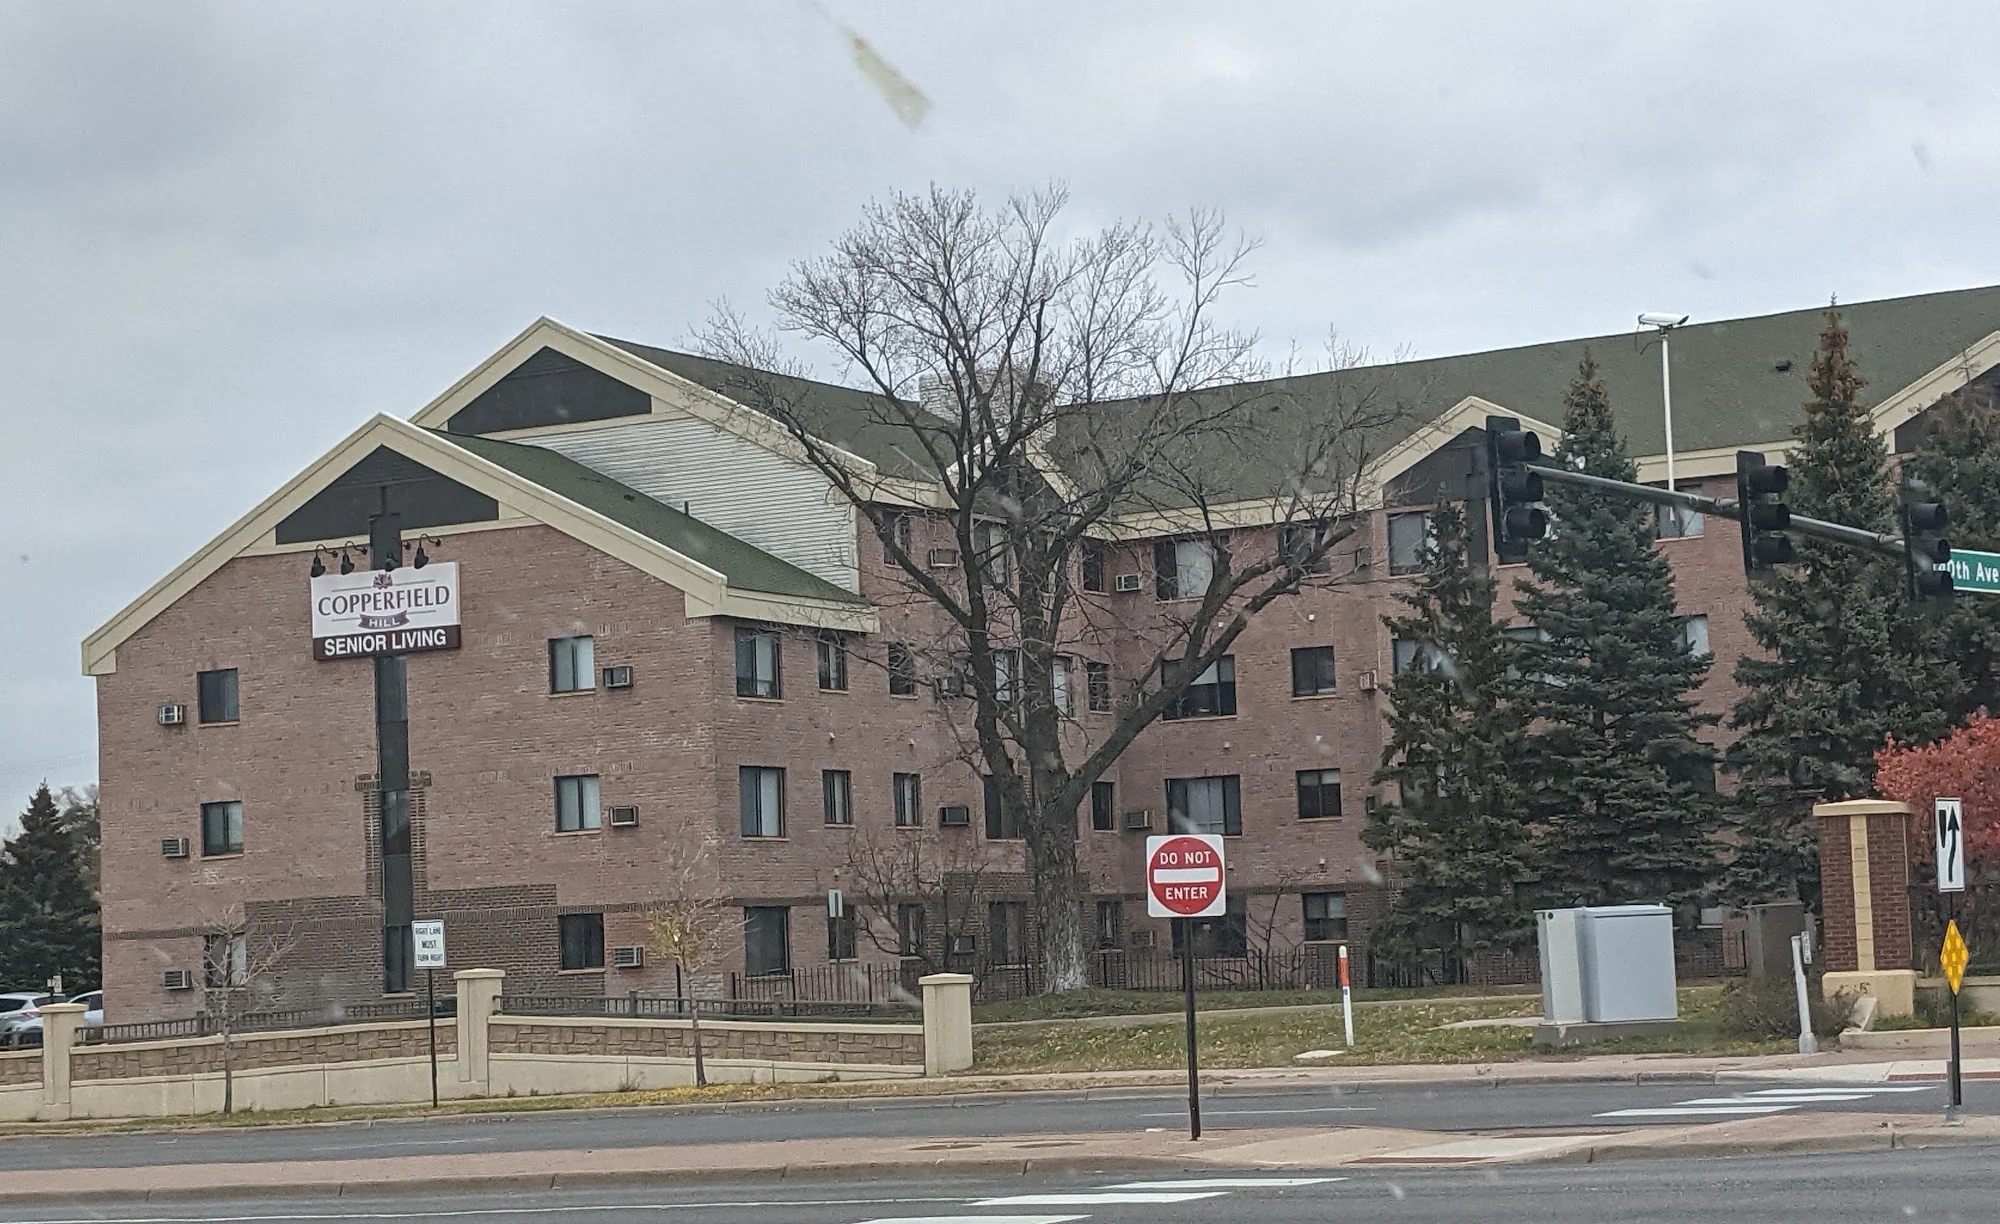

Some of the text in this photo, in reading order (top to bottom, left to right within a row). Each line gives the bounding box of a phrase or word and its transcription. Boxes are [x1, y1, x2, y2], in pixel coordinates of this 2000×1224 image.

[1976, 561, 2000, 583] Ave
[318, 585, 450, 616] COPPERFIELD
[368, 617, 401, 628] HILL
[324, 628, 447, 656] SENIOR LIVING
[1160, 850, 1212, 865] DO NOT
[1165, 886, 1209, 900] ENTER
